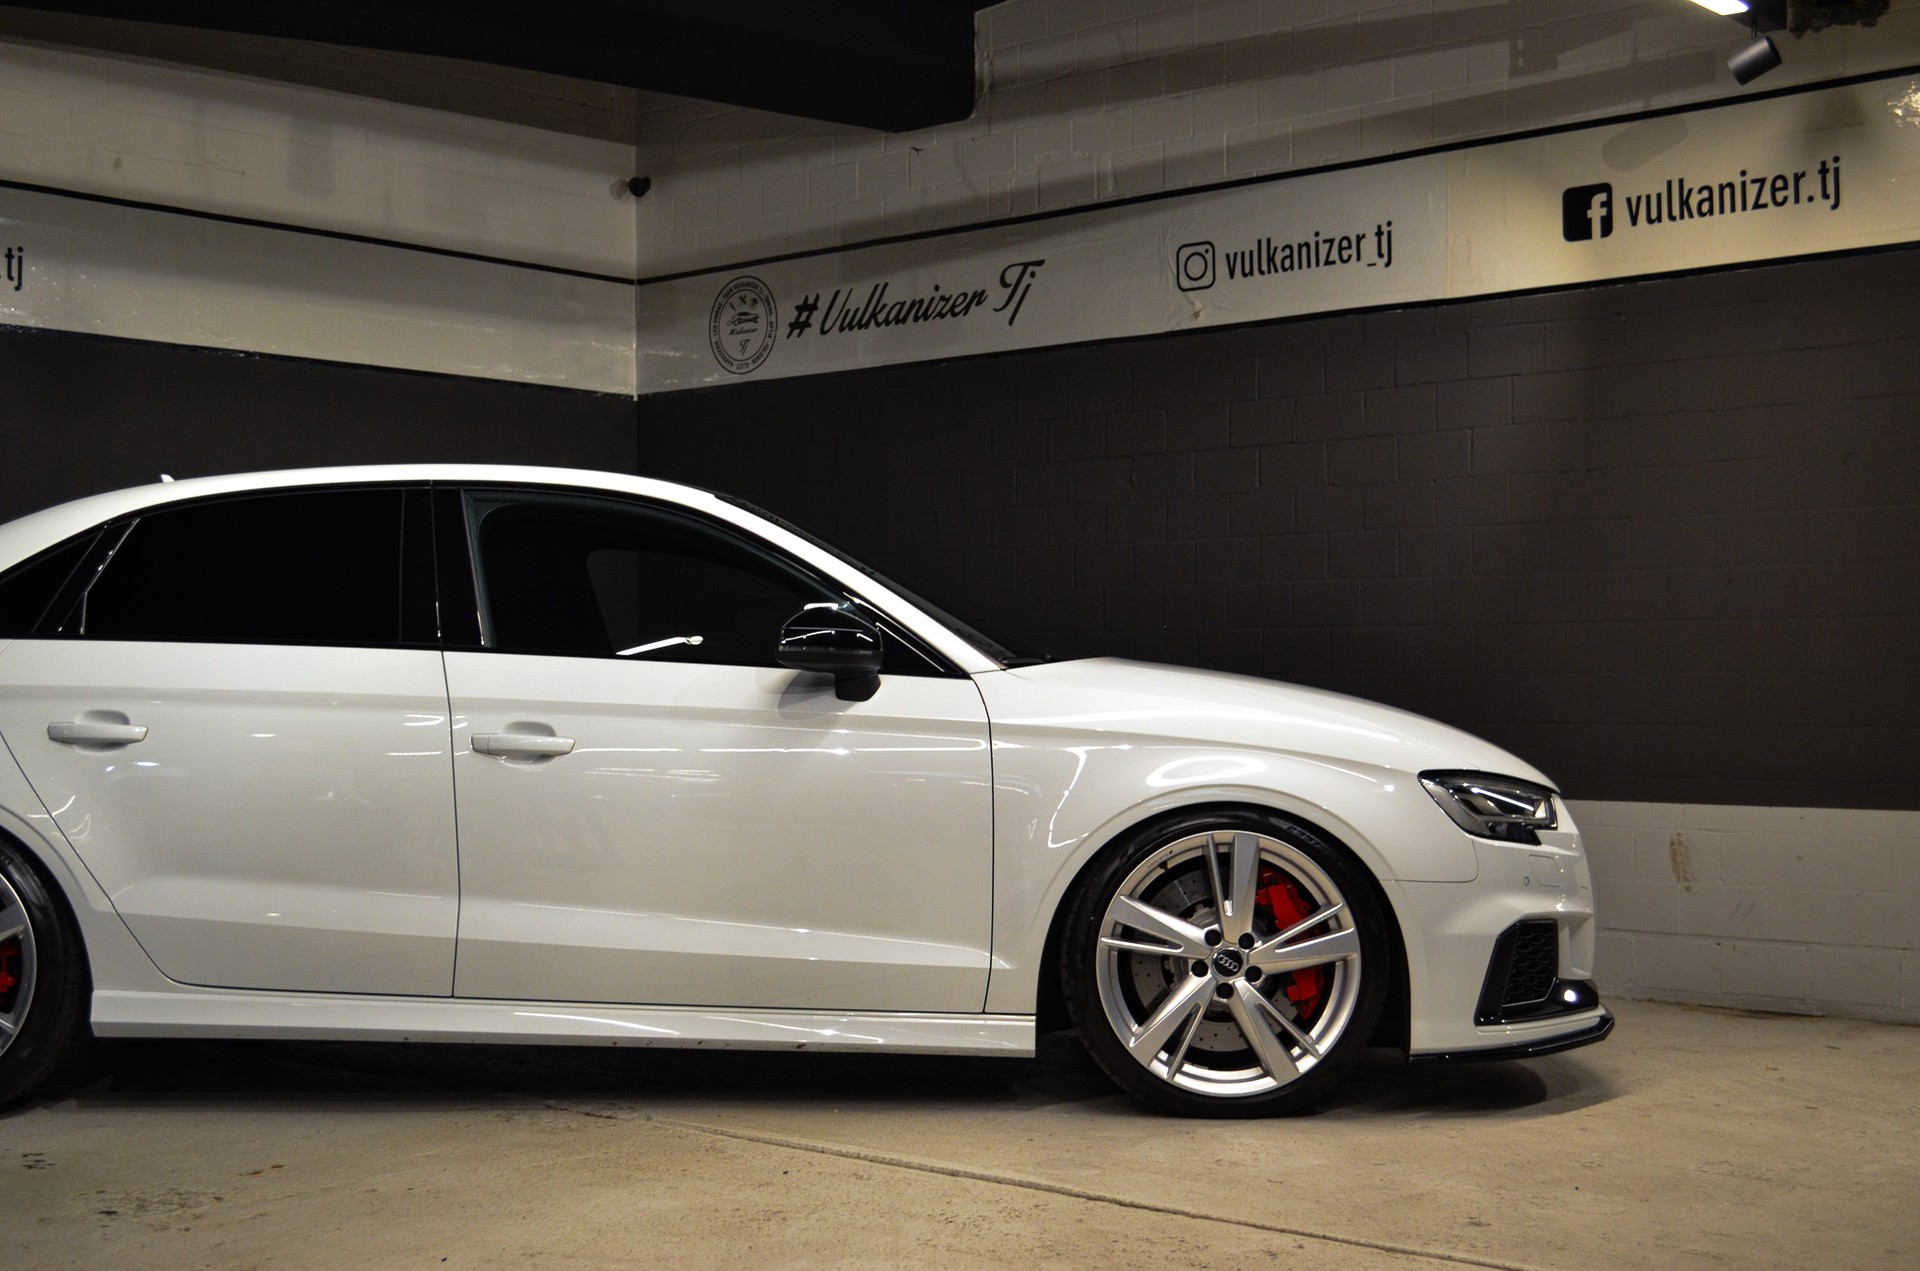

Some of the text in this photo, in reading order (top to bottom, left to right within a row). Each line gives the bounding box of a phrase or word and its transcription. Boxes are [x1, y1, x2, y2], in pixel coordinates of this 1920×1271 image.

[1625, 156, 1841, 226] vulkanizer.tj
[0, 246, 24, 292] tj
[1225, 220, 1392, 279] vulkanizer_tj
[787, 259, 1045, 339] #Vulkanizer Tj
